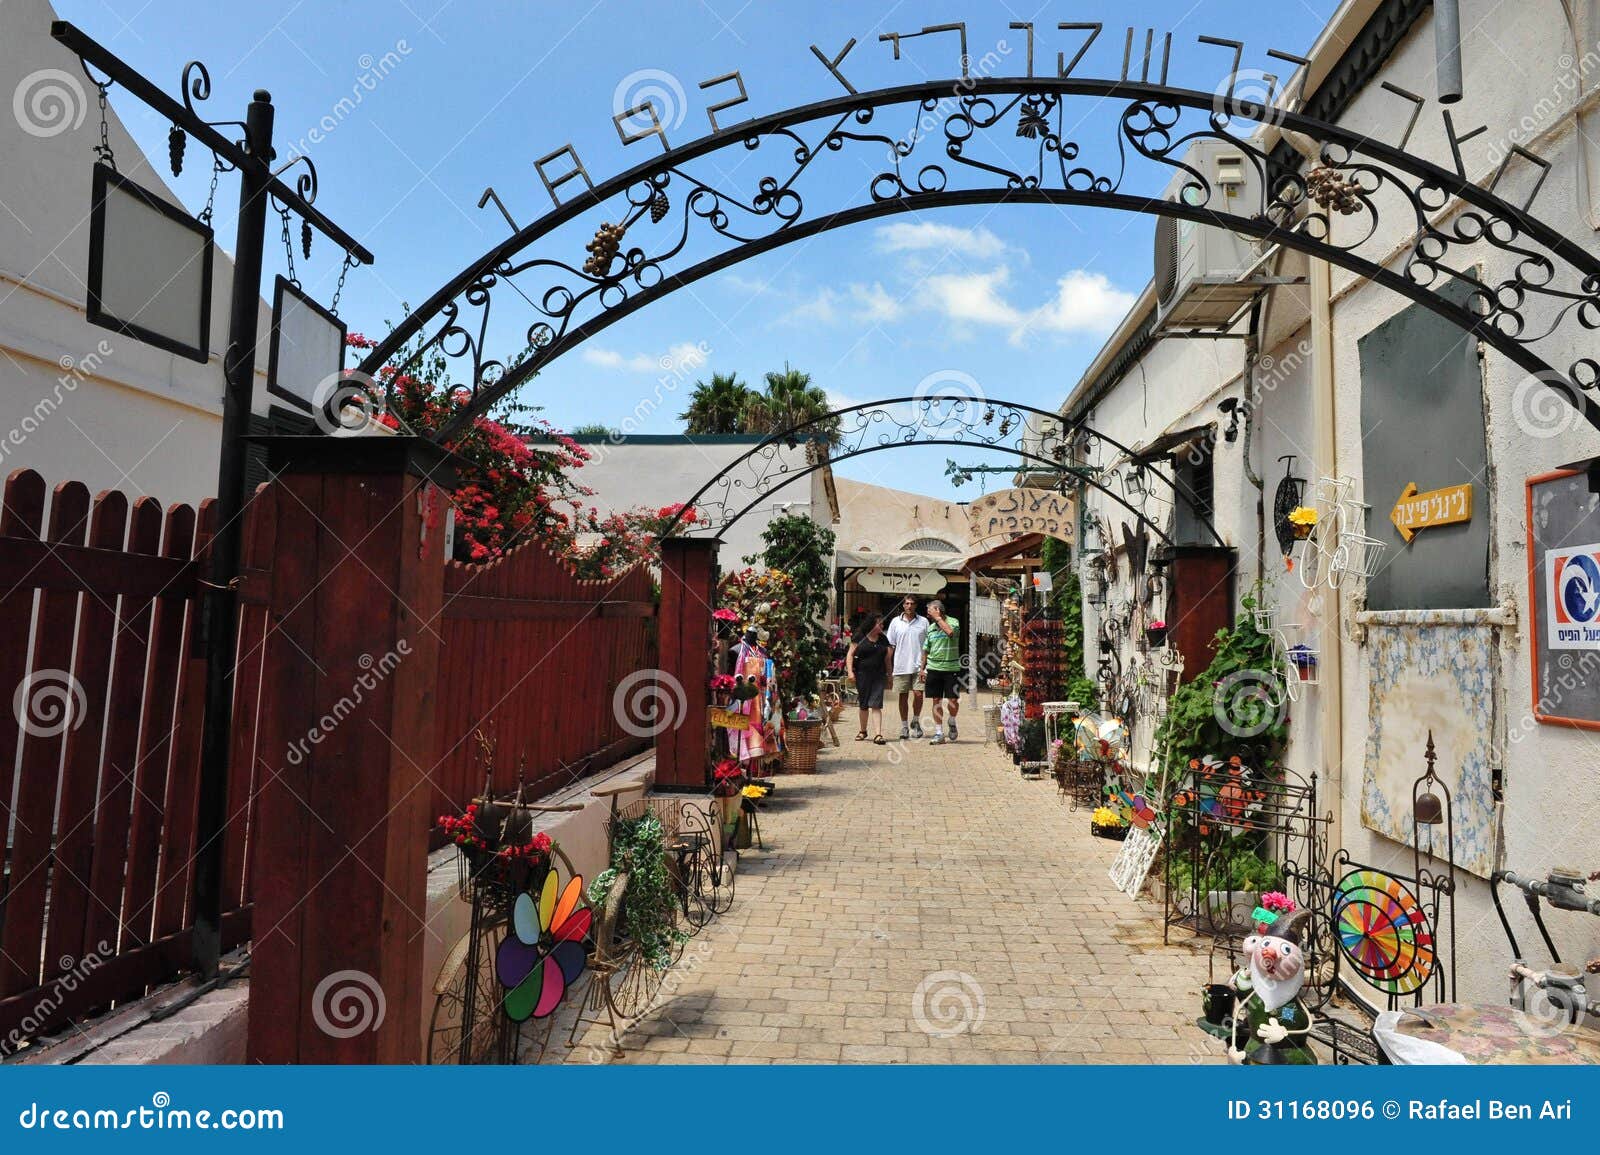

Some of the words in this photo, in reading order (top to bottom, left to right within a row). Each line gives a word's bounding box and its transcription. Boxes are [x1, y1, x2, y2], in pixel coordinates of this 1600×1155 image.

[477, 70, 749, 235] 1892
[998, 489, 1069, 516] מעוז
[1558, 629, 1581, 641] הפיס
[1583, 626, 1600, 641] פעל
